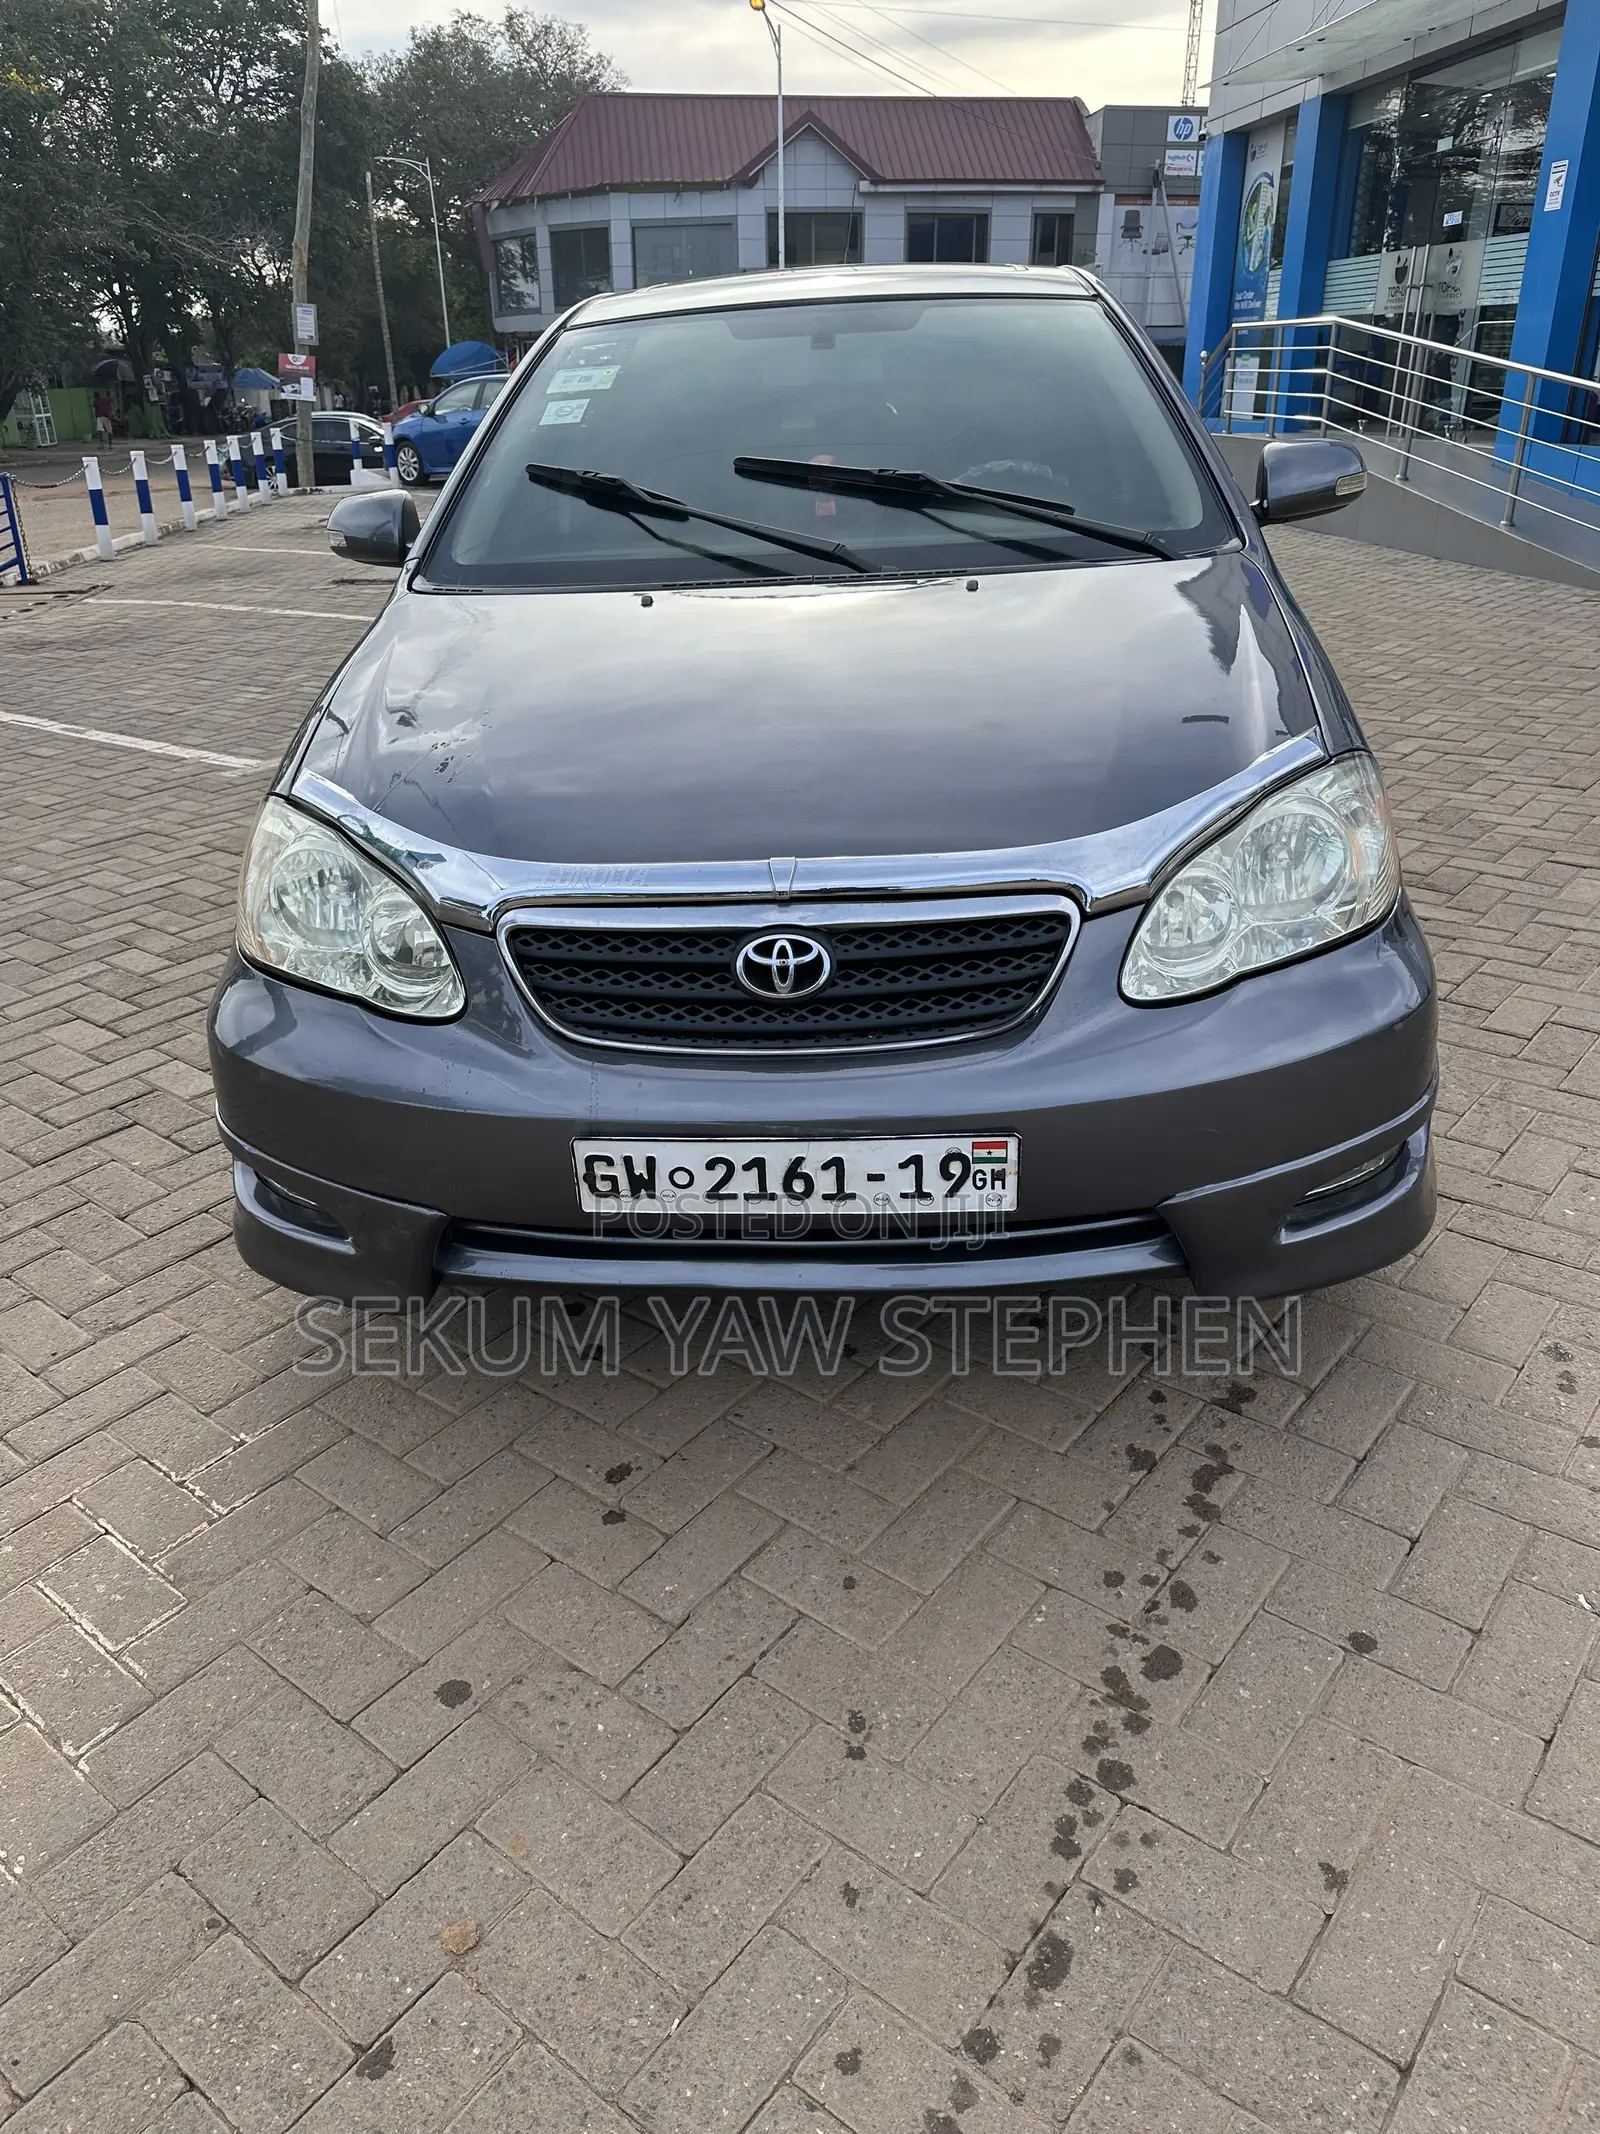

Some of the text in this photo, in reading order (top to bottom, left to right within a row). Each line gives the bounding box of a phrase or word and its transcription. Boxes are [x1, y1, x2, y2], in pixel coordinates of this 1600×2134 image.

[1175, 117, 1192, 140] hp
[1243, 290, 1255, 300] Order
[1388, 286, 1407, 298] TOP-U
[1248, 299, 1262, 308] Deliver
[539, 865, 649, 889] COROLLA
[583, 1154, 656, 1200] GW
[972, 1168, 1006, 1190] GH
